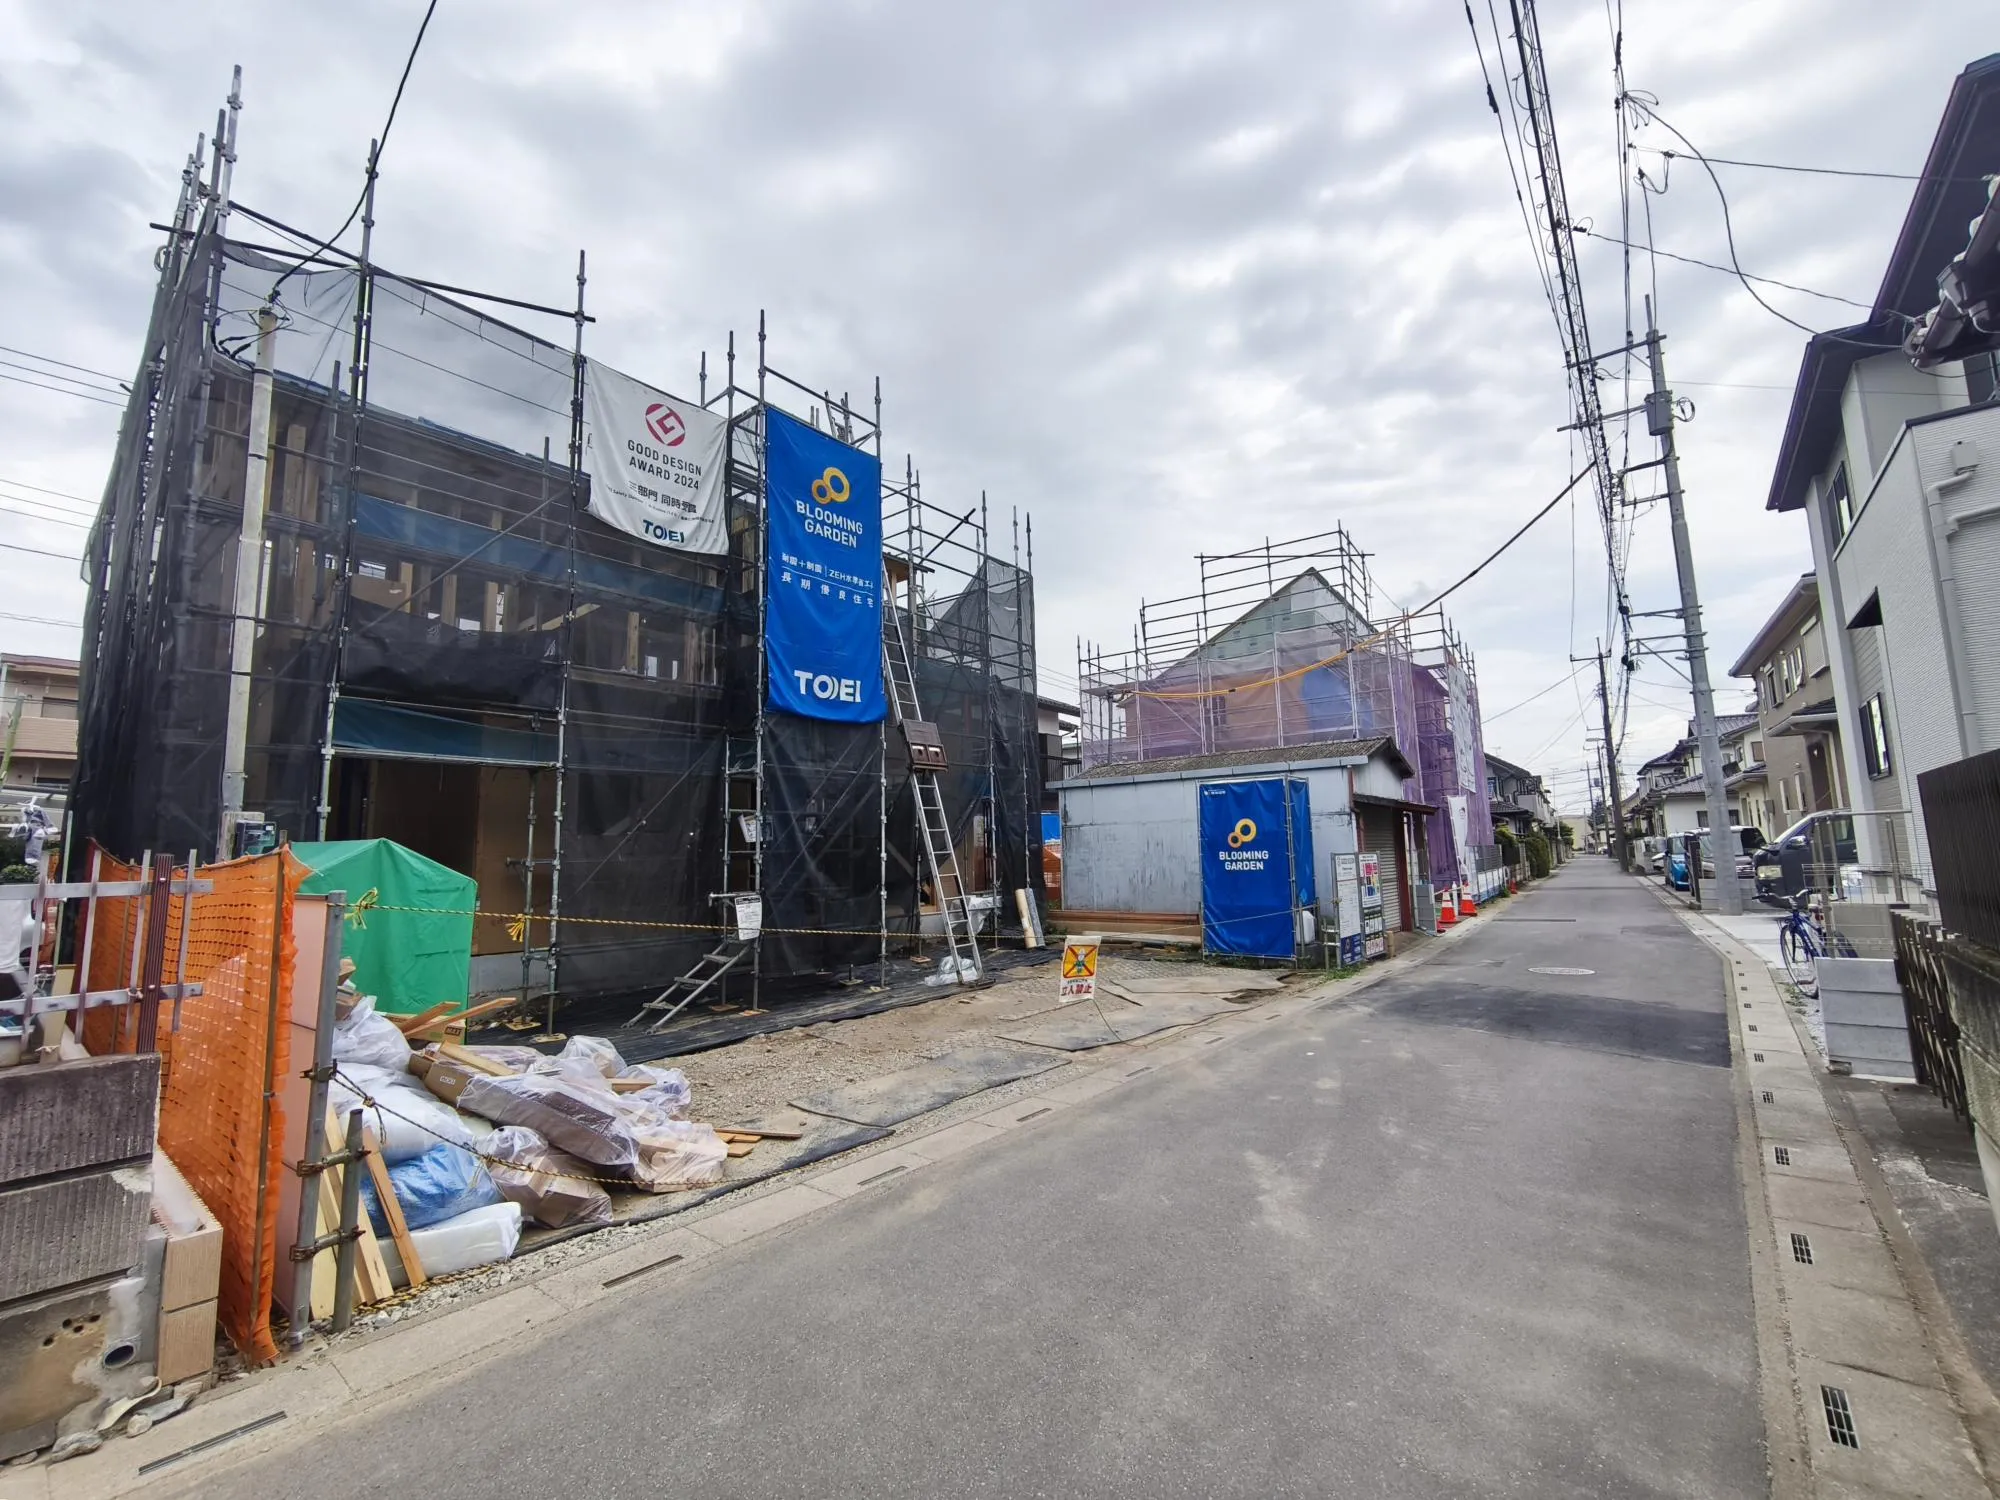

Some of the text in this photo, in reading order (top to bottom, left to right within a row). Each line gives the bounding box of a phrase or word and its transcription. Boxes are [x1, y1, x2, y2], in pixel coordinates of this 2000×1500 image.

[628, 440, 702, 476] GOOD DESIGN
[629, 457, 699, 490] AWARD 2024
[629, 481, 658, 502] 三部門
[796, 500, 863, 535] BLOOMING
[804, 519, 857, 548] GARDEN
[1219, 850, 1269, 860] BLOOMING
[1224, 861, 1264, 870] GARDEN
